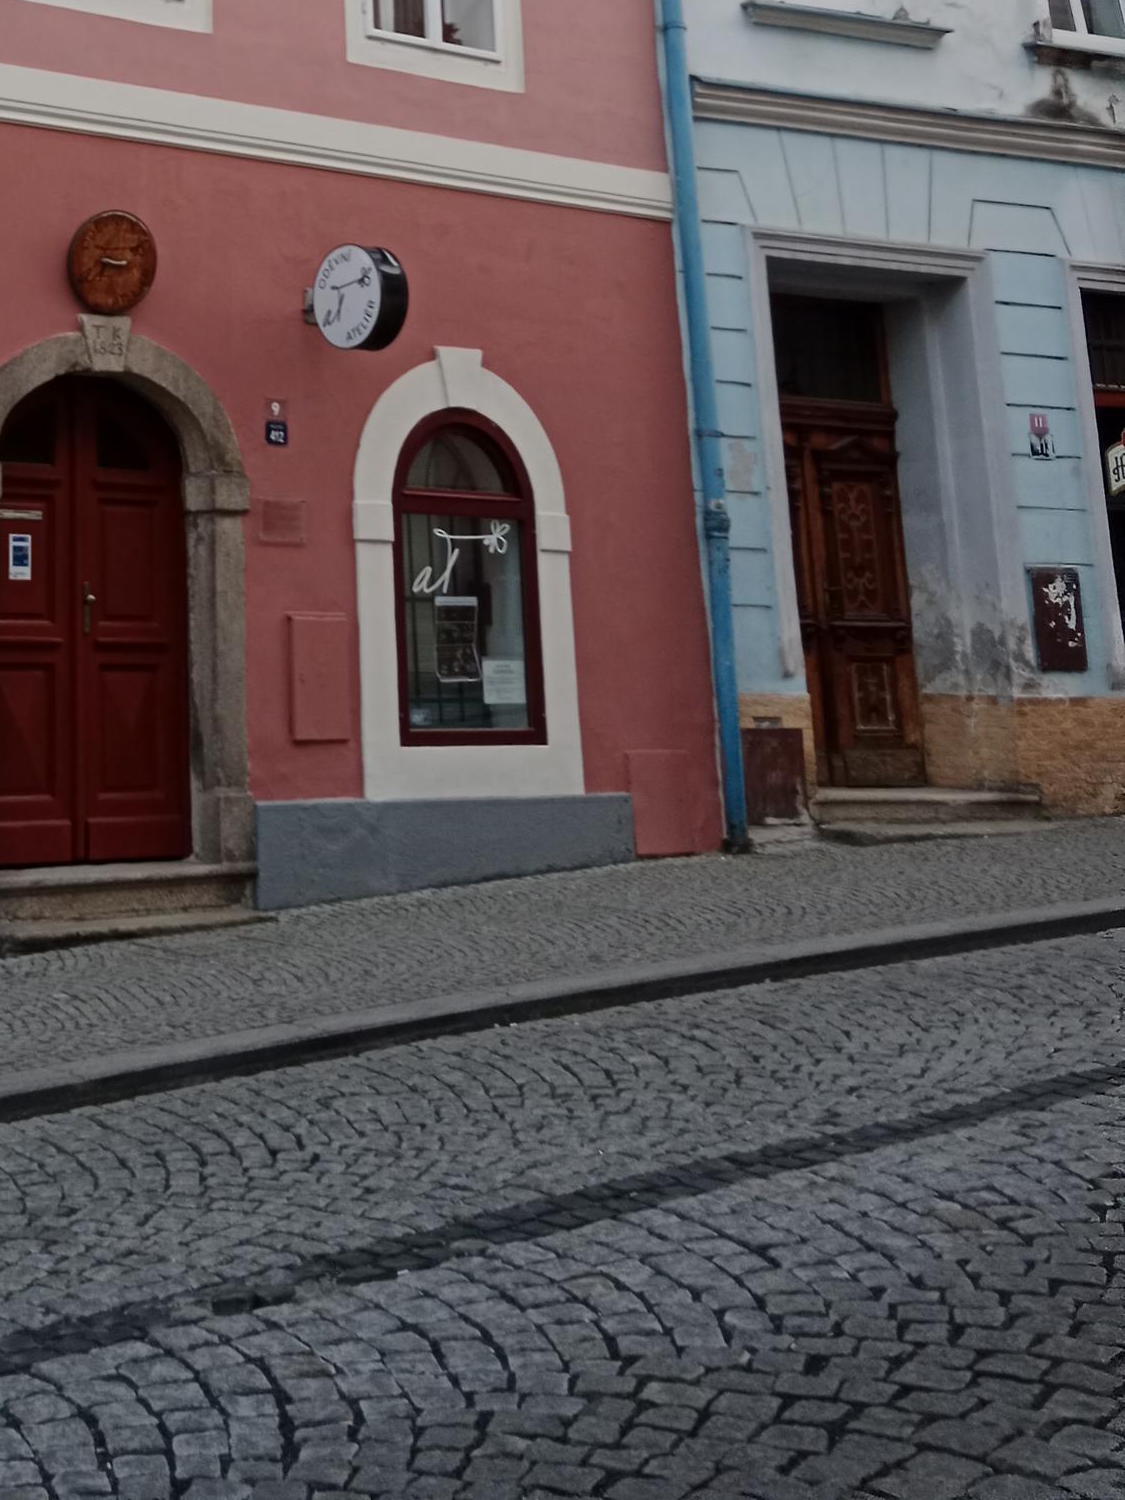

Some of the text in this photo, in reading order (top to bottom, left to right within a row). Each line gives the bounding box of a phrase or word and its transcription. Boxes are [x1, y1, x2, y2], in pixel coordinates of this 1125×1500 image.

[92, 324, 123, 341] T K
[271, 402, 280, 416] 9
[1034, 416, 1043, 428] 11
